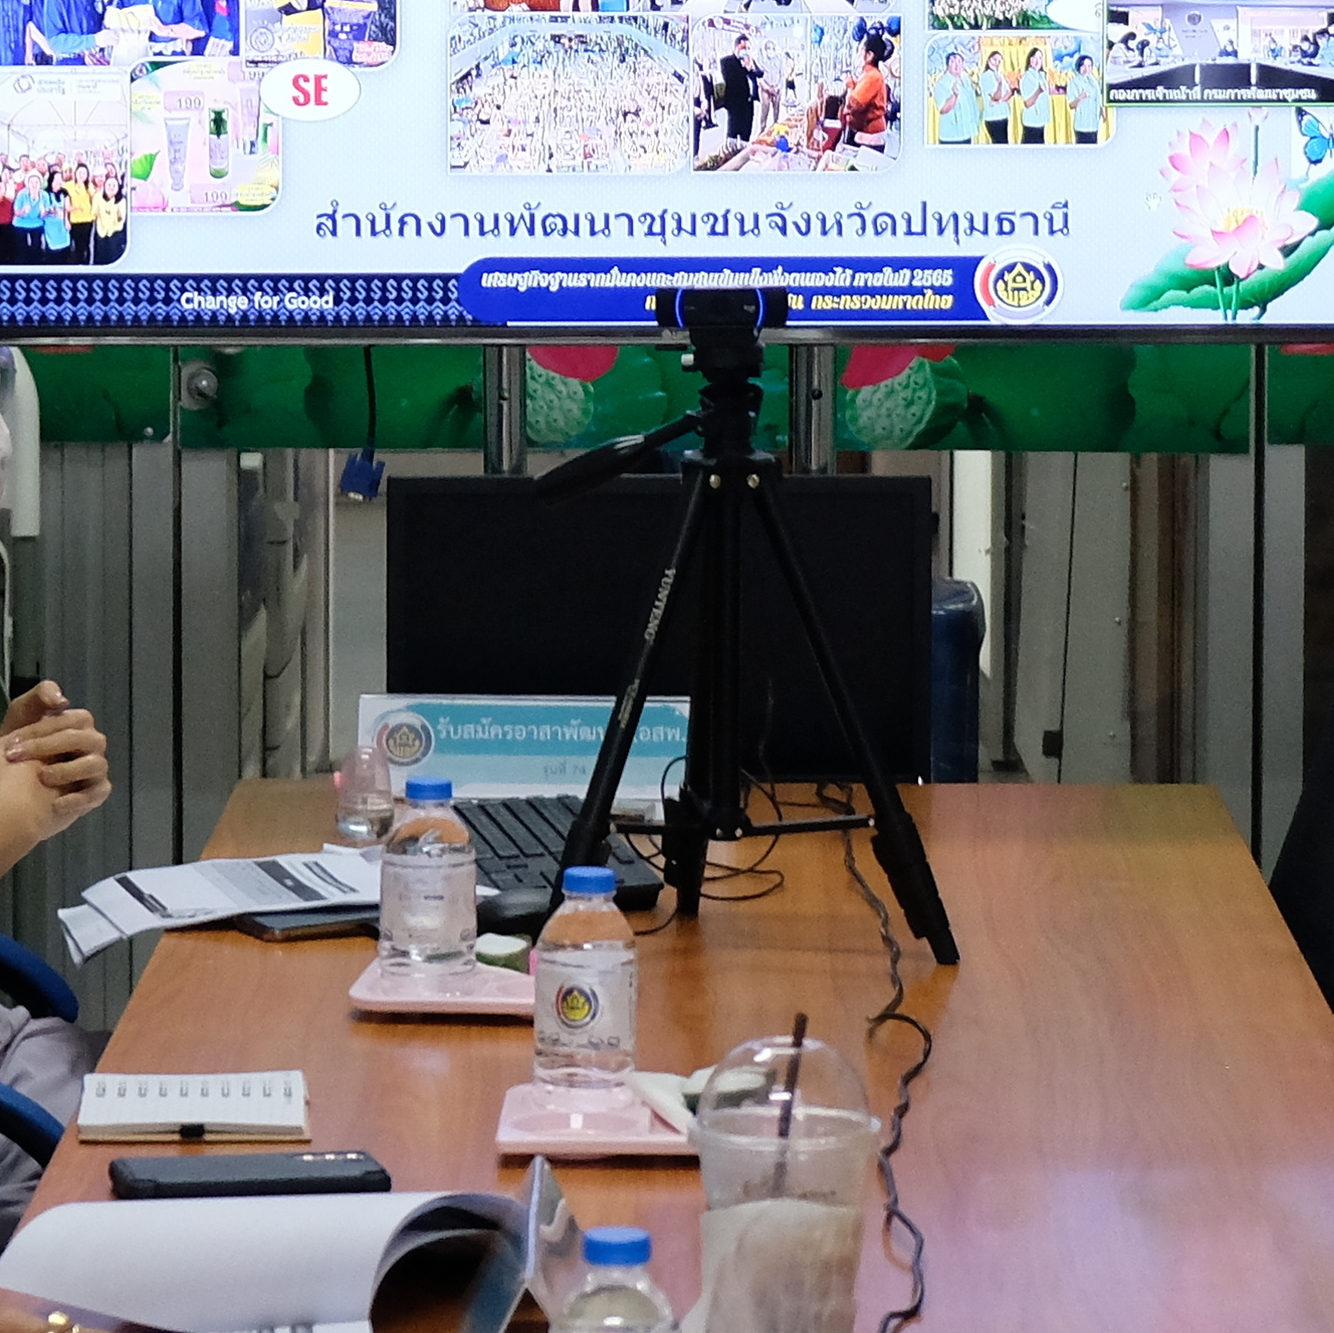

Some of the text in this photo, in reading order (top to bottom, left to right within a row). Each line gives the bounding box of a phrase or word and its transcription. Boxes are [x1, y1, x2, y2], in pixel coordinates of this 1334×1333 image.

[291, 73, 330, 107] SE
[314, 199, 1071, 247] สำนักงานพัฒนาชุมชนจังหวัดปทุมธานี
[912, 268, 955, 288] 2565
[180, 291, 335, 313] Change for Good
[436, 716, 605, 742] รับสมัครอาสาพัฒ
